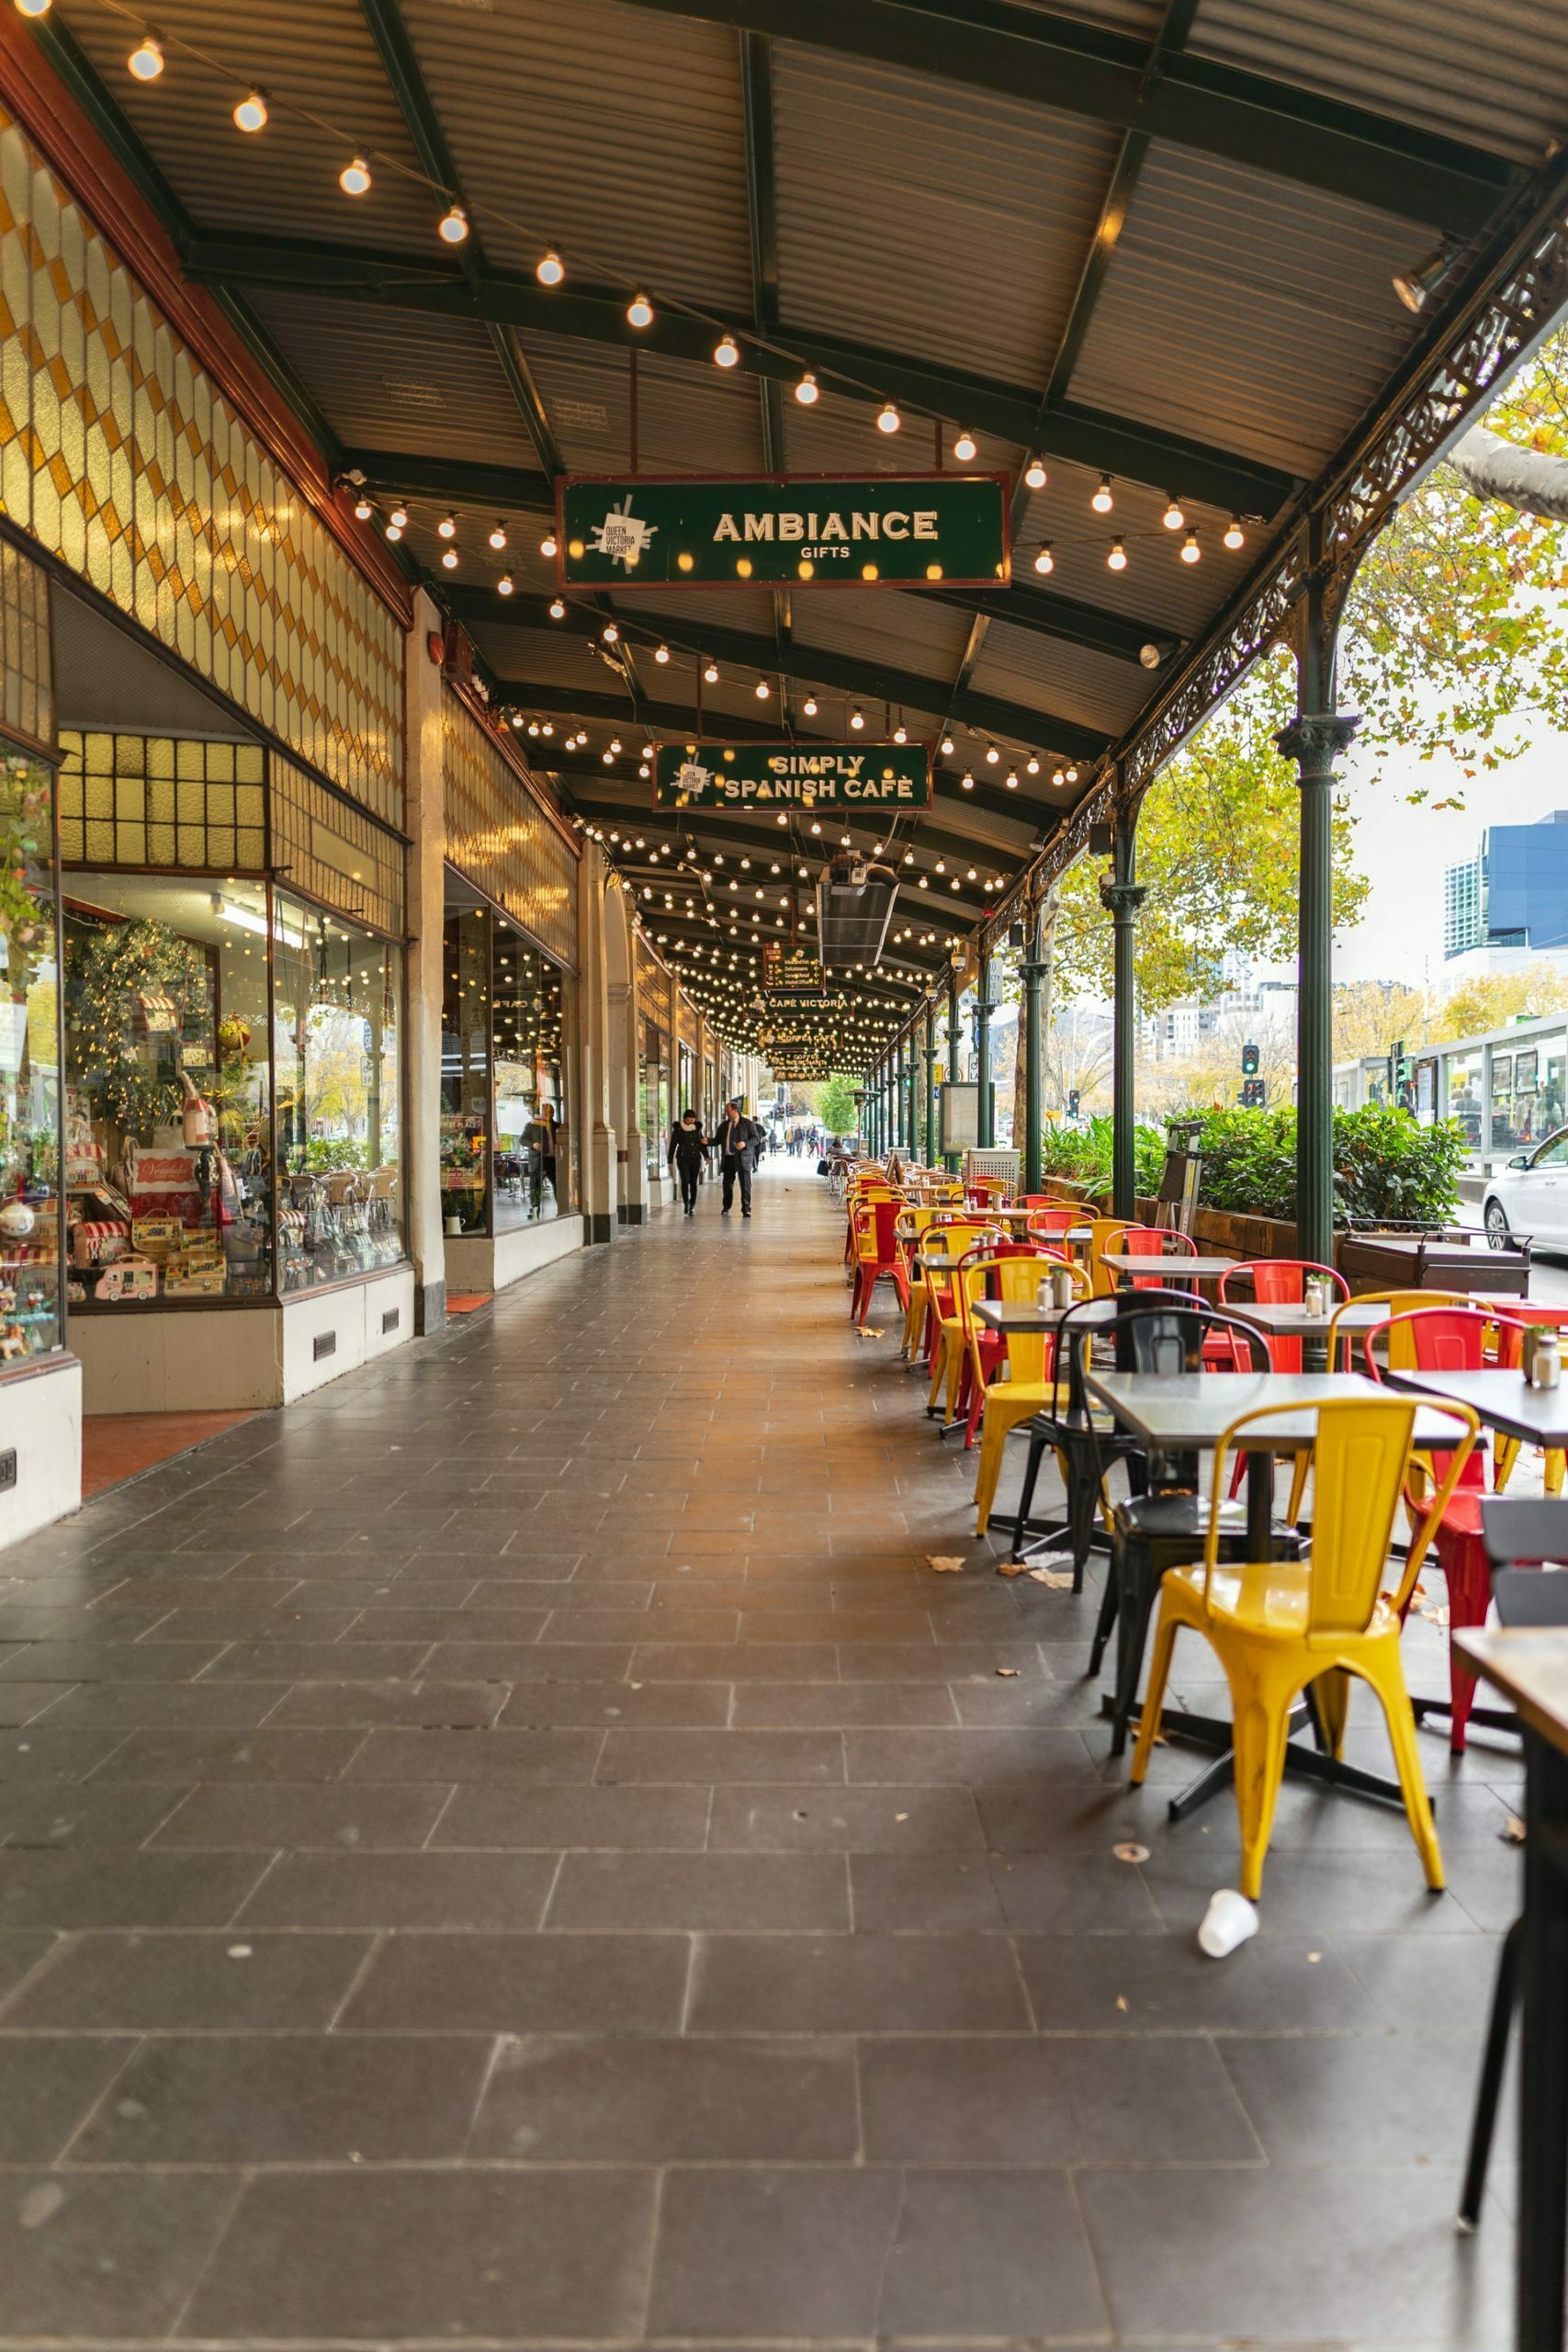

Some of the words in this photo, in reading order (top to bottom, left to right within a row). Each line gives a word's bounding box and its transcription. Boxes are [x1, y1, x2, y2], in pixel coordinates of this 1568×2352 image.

[605, 526, 626, 537] QUEEN
[713, 510, 939, 541] AMBIANCE
[605, 536, 636, 546] VICTORIA
[605, 545, 632, 556] MARKET
[800, 547, 851, 559] GIFTS
[773, 755, 866, 775] SIMPLY
[724, 779, 837, 798] SPANISH
[141, 1160, 187, 1176] Vendula
